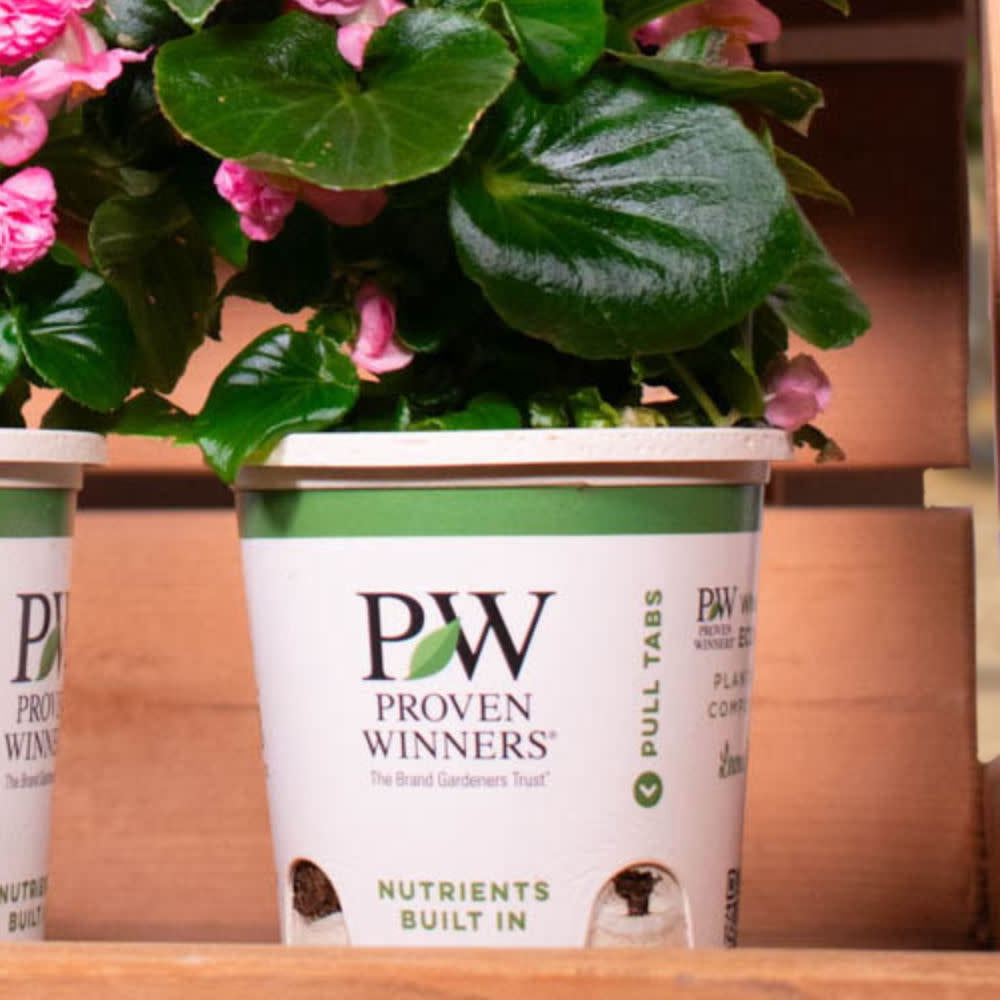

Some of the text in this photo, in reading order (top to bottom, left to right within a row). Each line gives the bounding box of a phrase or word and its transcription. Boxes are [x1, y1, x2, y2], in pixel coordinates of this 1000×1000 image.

[356, 591, 556, 681] PW
[641, 589, 662, 758] PULL TABS
[376, 693, 532, 722] PROVEN
[371, 771, 392, 786] The
[396, 771, 433, 787] Brand
[438, 772, 507, 787] Gardeners
[379, 880, 550, 901] NUTRIENTS
[402, 911, 526, 930] BUILT IN
